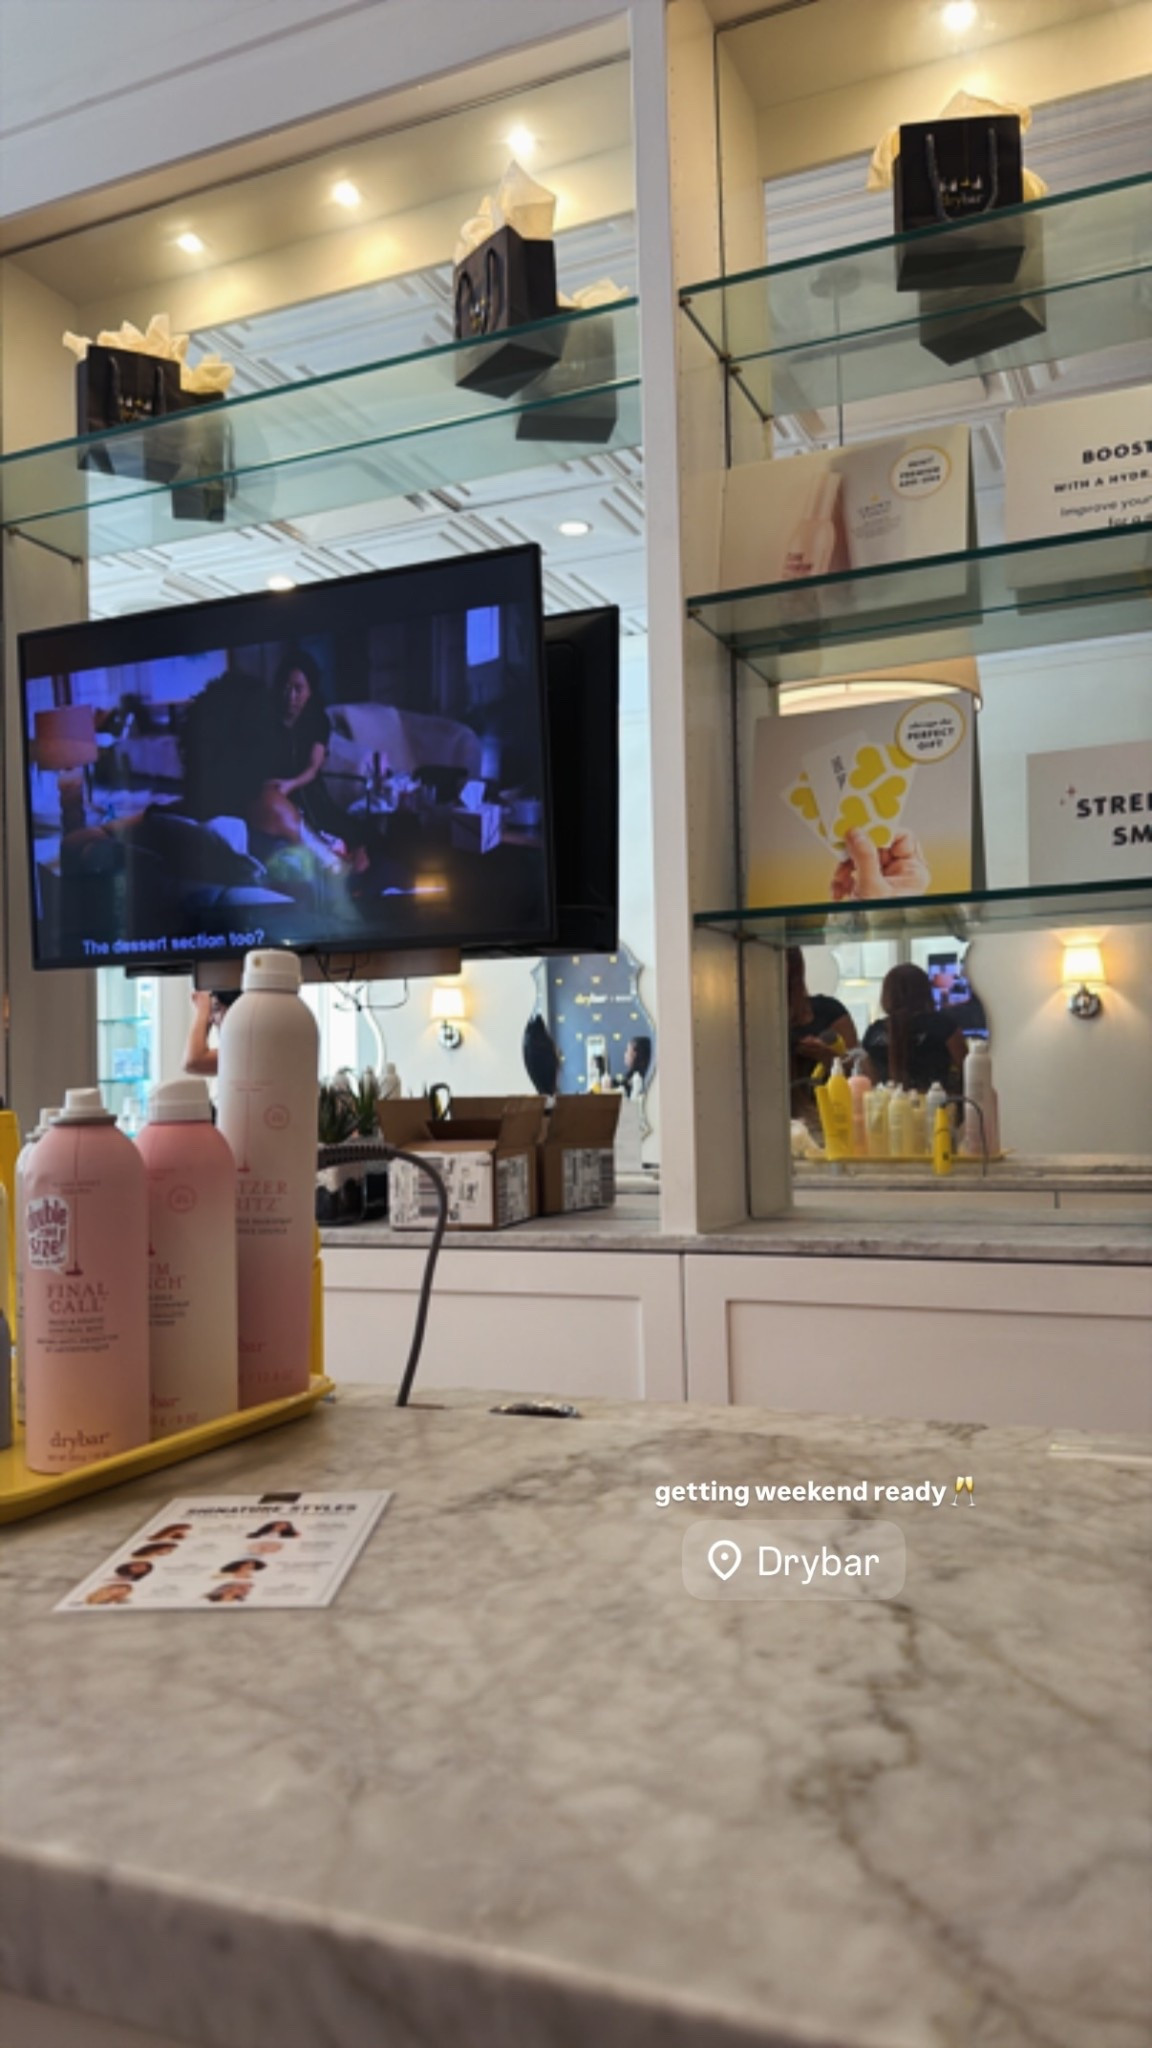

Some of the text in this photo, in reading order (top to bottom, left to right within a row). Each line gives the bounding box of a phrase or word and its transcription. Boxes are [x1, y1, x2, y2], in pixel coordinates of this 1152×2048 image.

[1082, 440, 1152, 464] BOOST
[1053, 478, 1090, 493] WITH
[1095, 477, 1104, 487] A
[907, 727, 955, 741] PERFECT
[1077, 791, 1152, 819] STRE
[83, 928, 265, 955] The dessert section too?
[46, 1283, 109, 1299] FINAL
[48, 1299, 104, 1316] CALL
[50, 1430, 107, 1452] drybar
